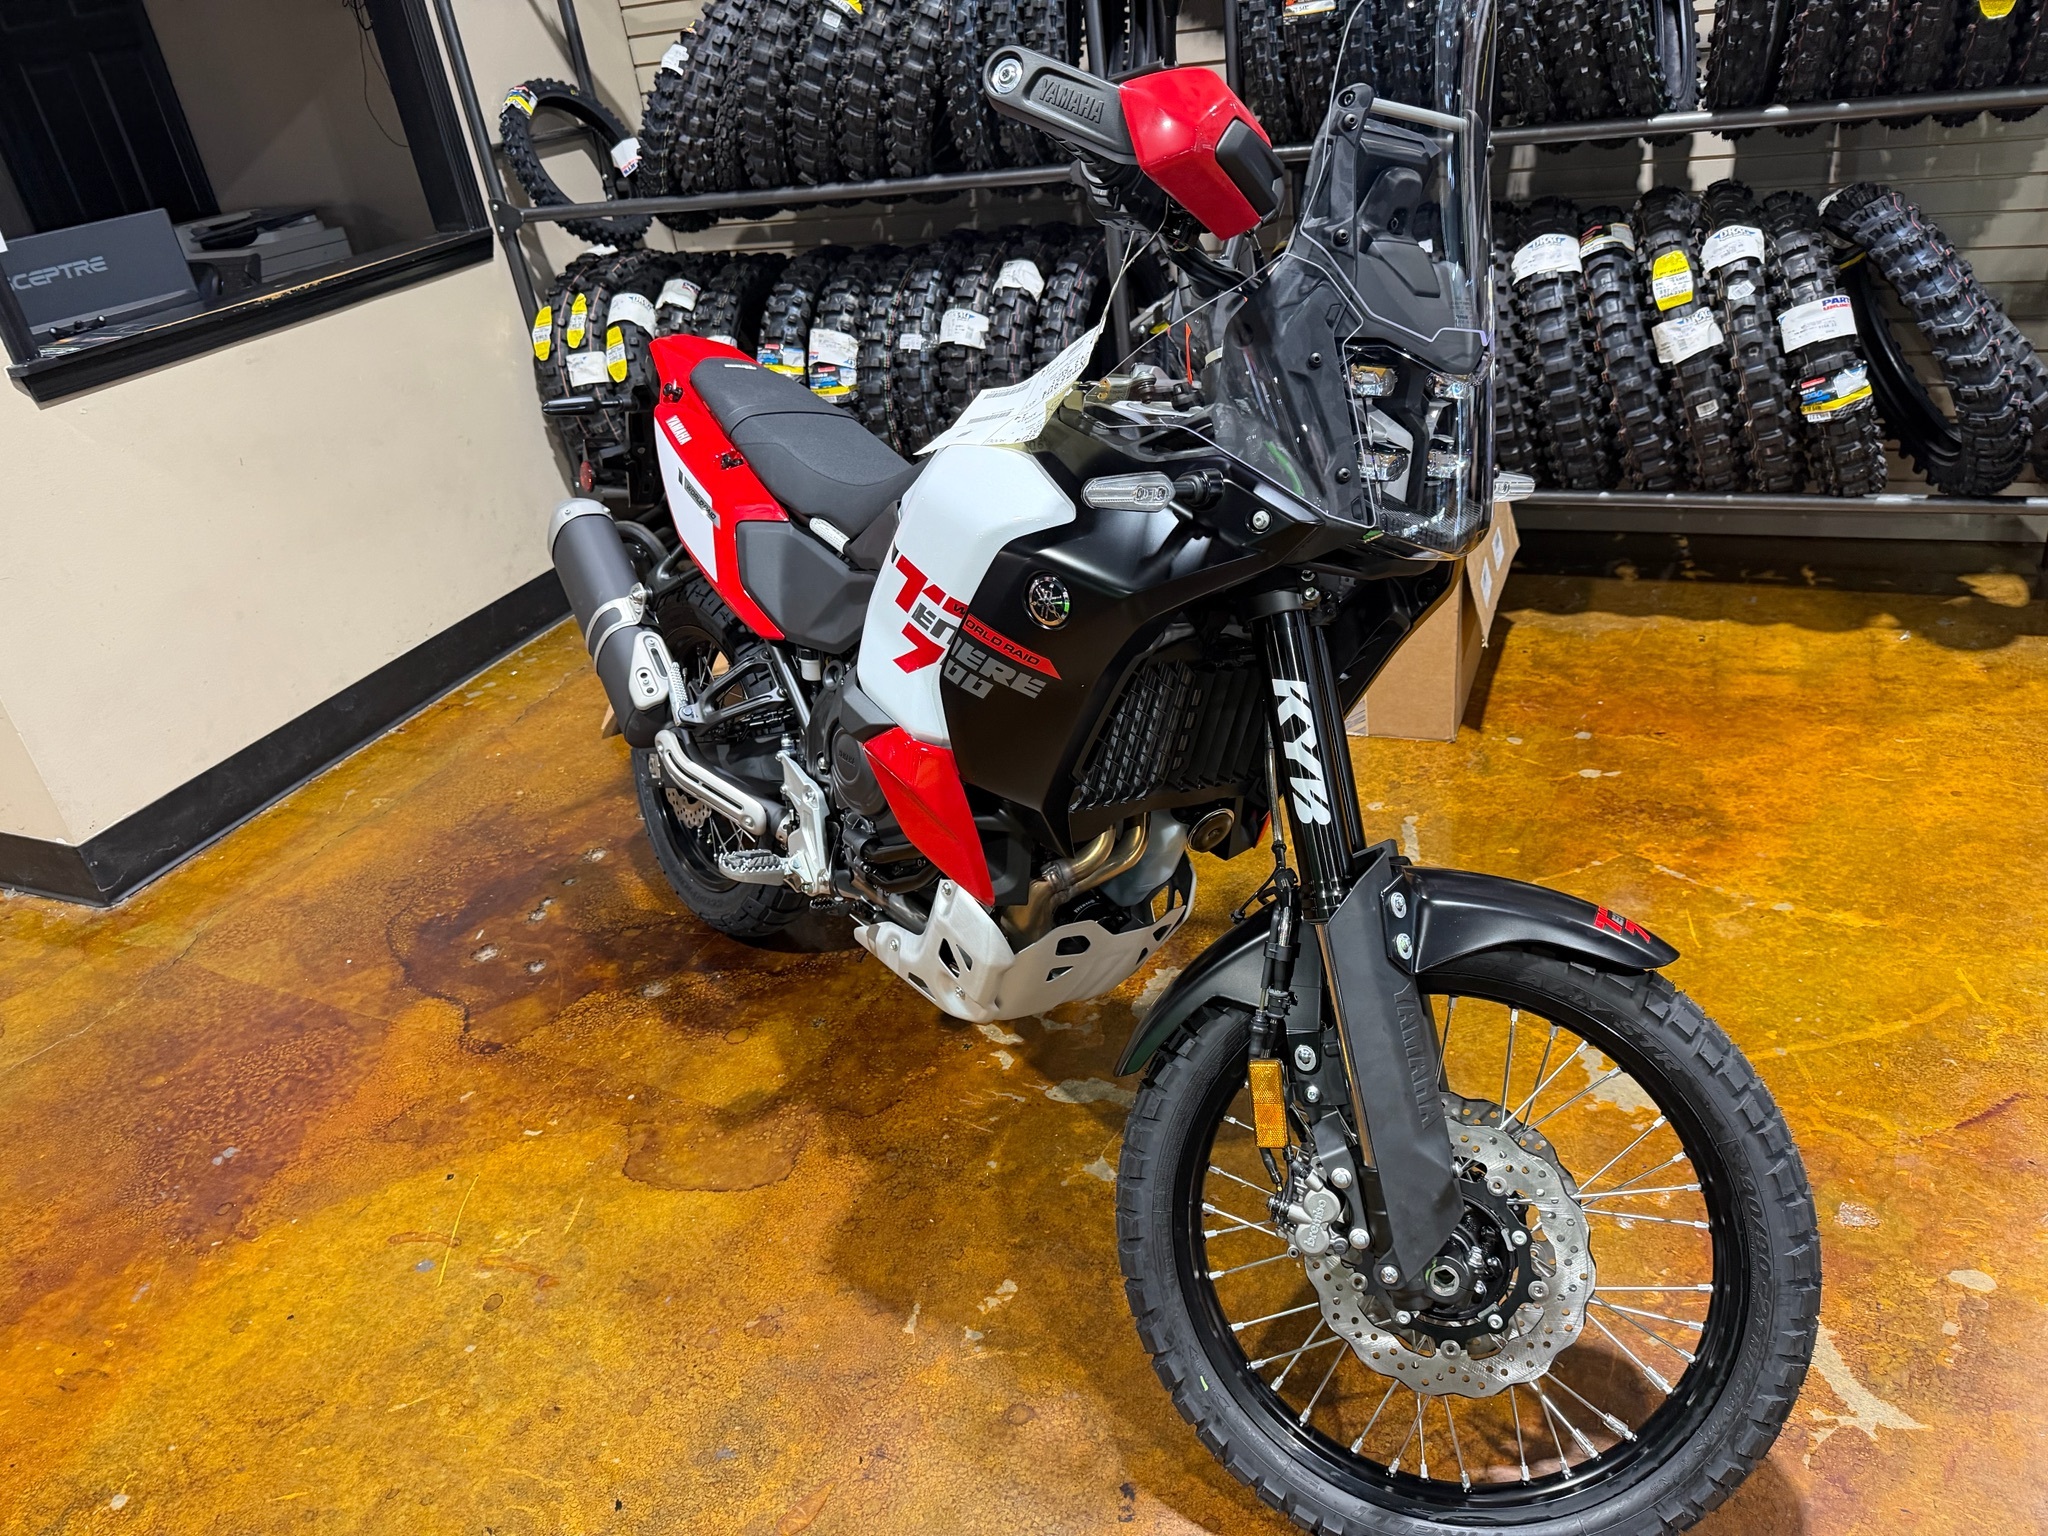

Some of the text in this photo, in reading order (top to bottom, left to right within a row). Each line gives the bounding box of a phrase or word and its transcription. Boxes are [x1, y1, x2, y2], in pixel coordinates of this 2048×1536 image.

[1039, 78, 1104, 125] YAMAHA
[665, 414, 692, 445] YAMAHA
[686, 484, 705, 507] WORLD
[952, 602, 1041, 668] WORLD RAID
[1271, 678, 1332, 826] KYB
[1393, 981, 1443, 1131] YAMAHA
[1303, 1199, 1327, 1248] brembo
